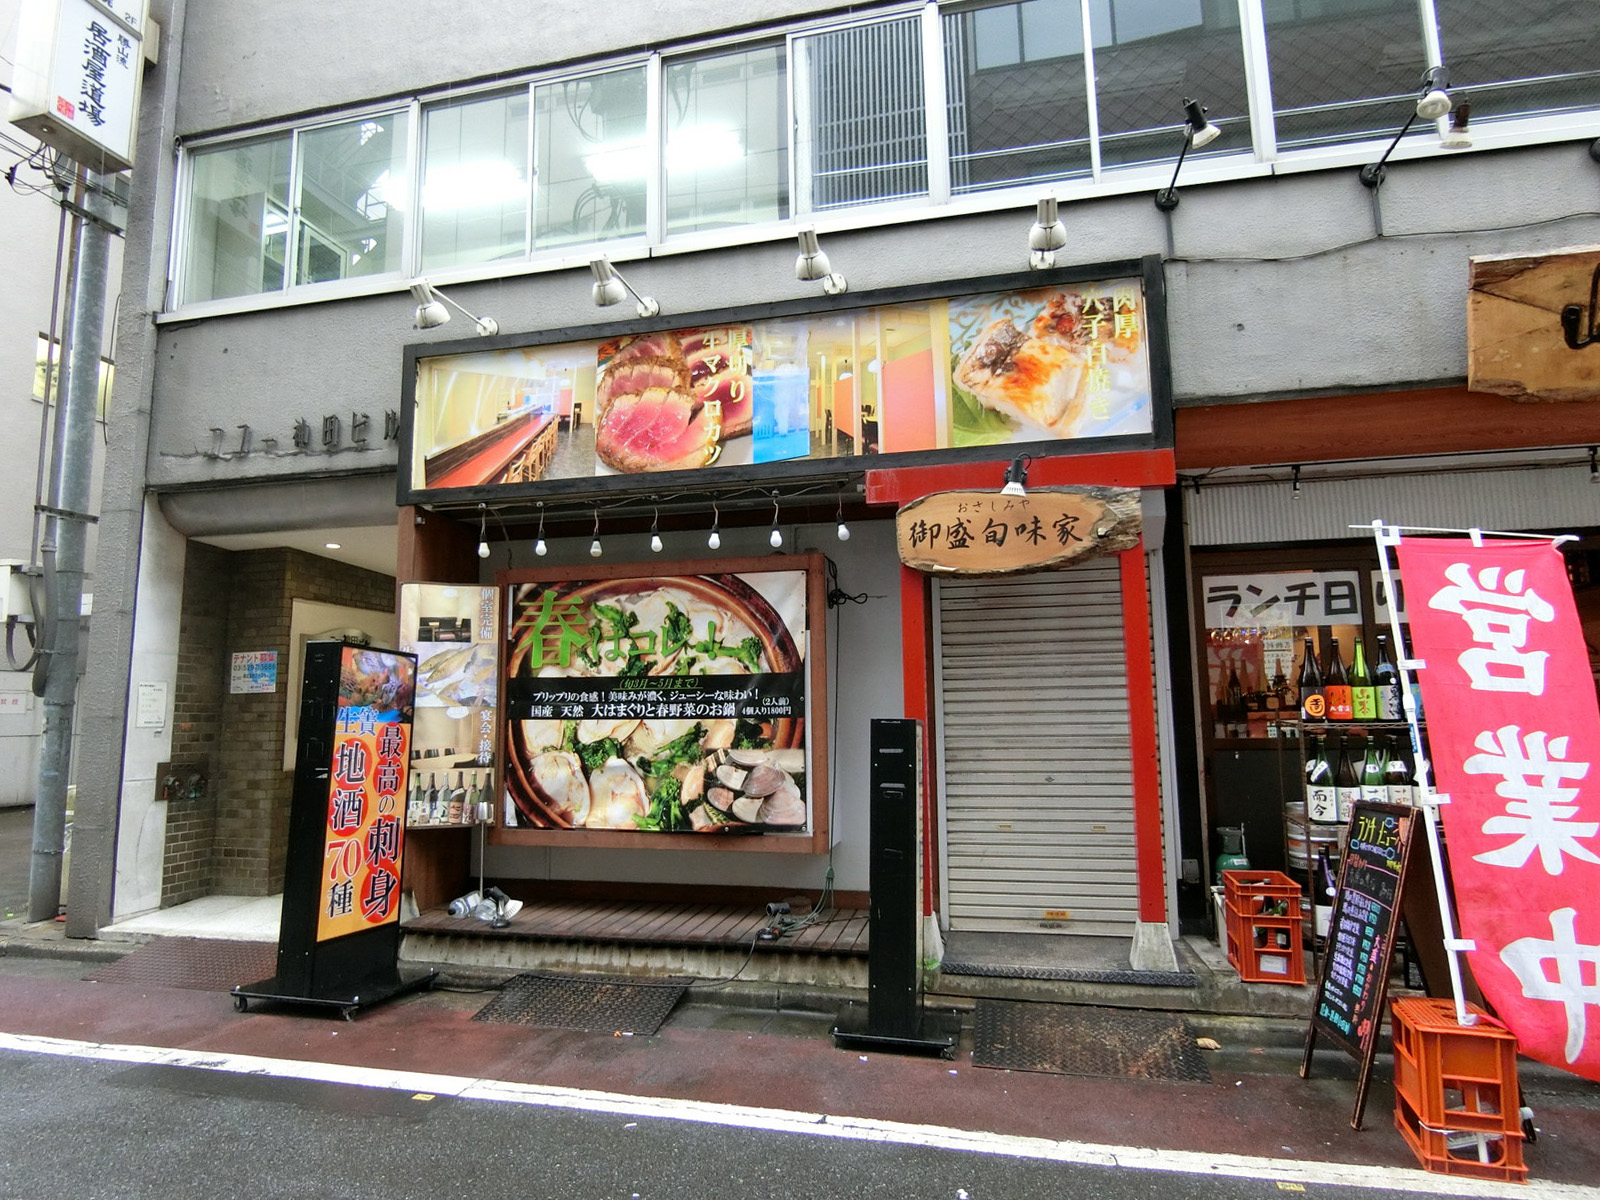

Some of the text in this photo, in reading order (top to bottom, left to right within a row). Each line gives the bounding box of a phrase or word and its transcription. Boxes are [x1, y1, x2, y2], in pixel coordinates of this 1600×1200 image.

[124, 12, 137, 25] 2F
[78, 21, 112, 127] 居酒屋道場
[1113, 288, 1139, 339] 肉厚
[728, 329, 748, 403] 厚切り
[908, 513, 1084, 550] 御盛旬味家
[958, 500, 1030, 513] おさしみや
[479, 588, 494, 640] 個室完備
[1207, 580, 1358, 617] ランチ日
[516, 590, 719, 668] 春はコレ！
[233, 653, 275, 664] テナント募集
[531, 702, 736, 718] 国産 天然 大はまぐりと春野菜のお鍋
[478, 709, 493, 764] 宴会・接待
[325, 742, 367, 919] 地酒70種
[364, 726, 402, 919] 最高の刺身
[1428, 562, 1600, 1064] 営業中
